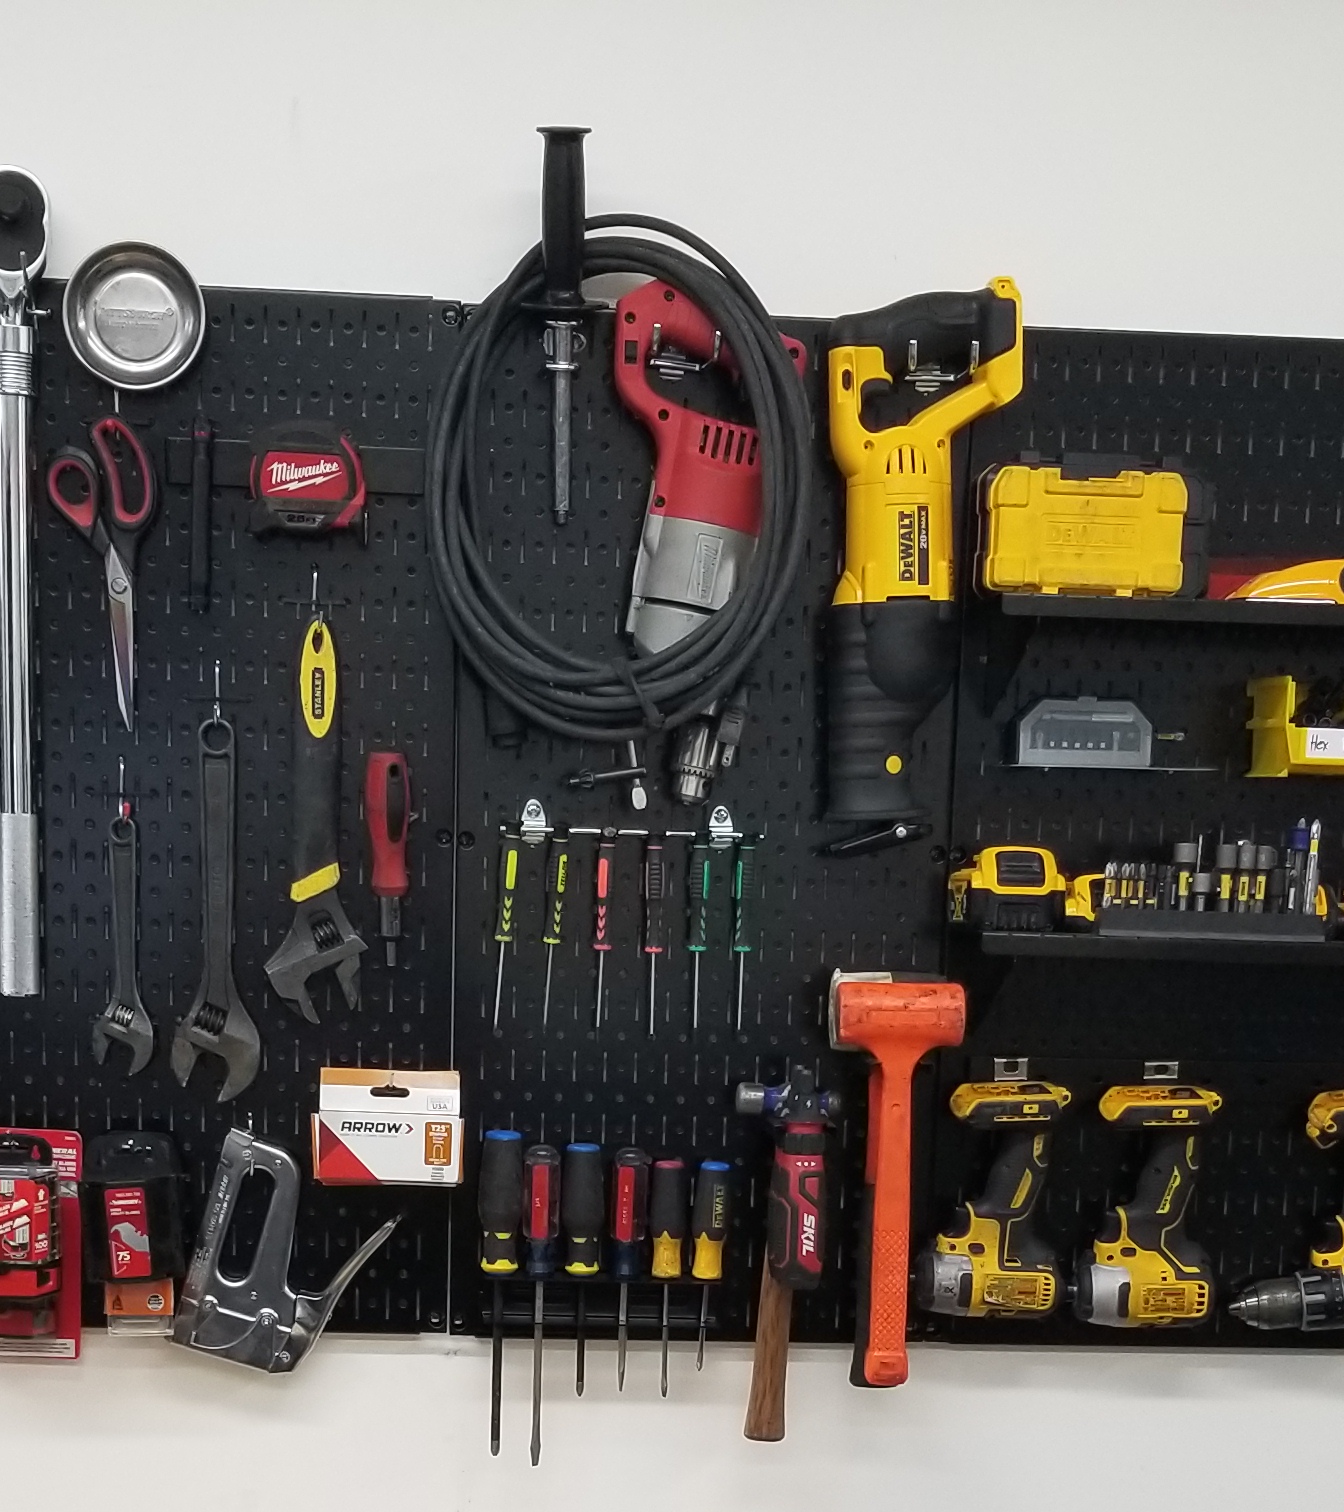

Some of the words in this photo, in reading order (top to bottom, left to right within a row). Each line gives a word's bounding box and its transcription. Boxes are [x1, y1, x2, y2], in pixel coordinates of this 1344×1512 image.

[267, 459, 340, 485] Milwaukee
[314, 671, 322, 715] STANLEY
[1310, 733, 1329, 752] Hex
[340, 1121, 403, 1134] ARROW
[801, 1213, 816, 1256] SKIL
[117, 1250, 131, 1261] 75
